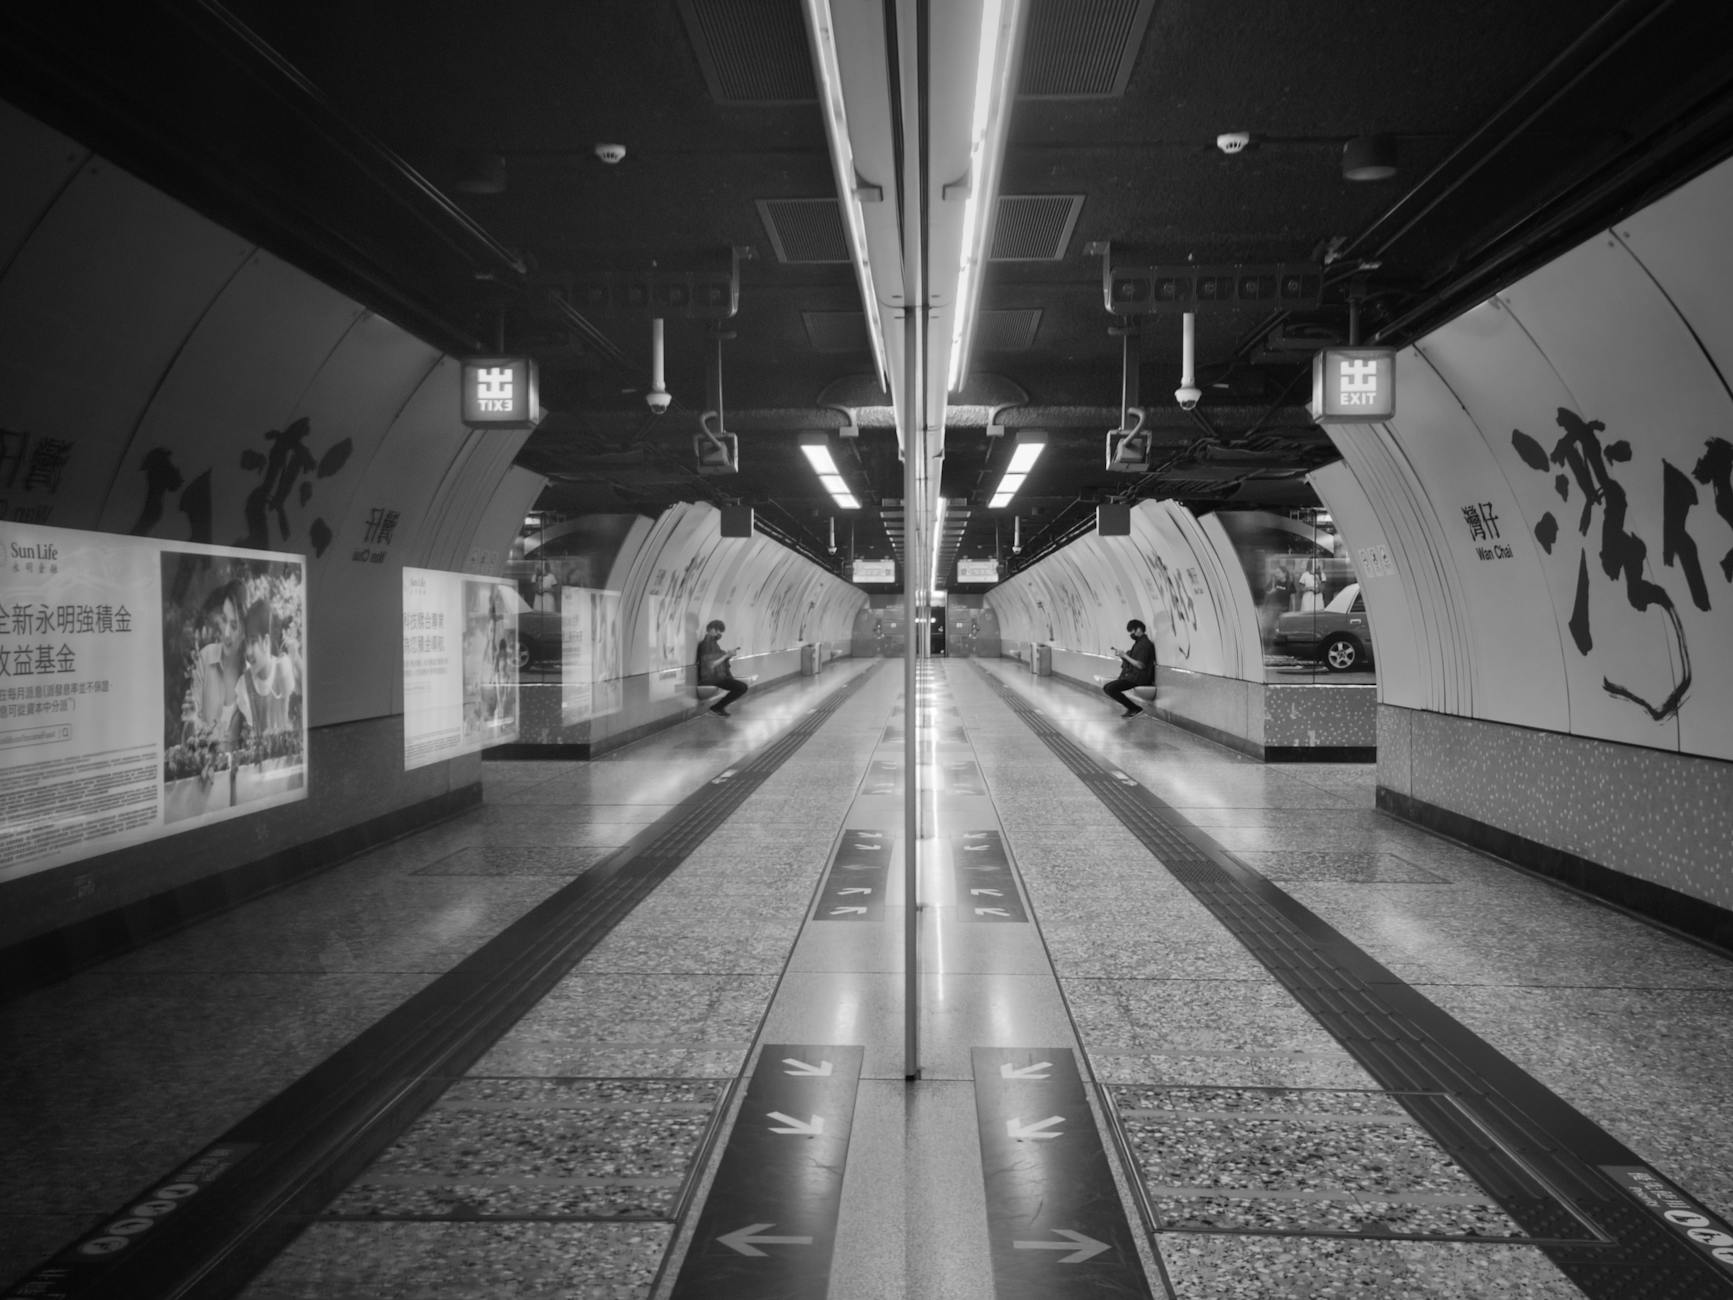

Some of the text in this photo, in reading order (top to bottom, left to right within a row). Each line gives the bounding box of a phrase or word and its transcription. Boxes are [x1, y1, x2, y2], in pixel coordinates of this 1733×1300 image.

[1340, 392, 1377, 406] EXIT
[1460, 501, 1500, 541] 灣仔
[11, 542, 58, 560] Sun Life
[1475, 544, 1514, 561] Wan Chai
